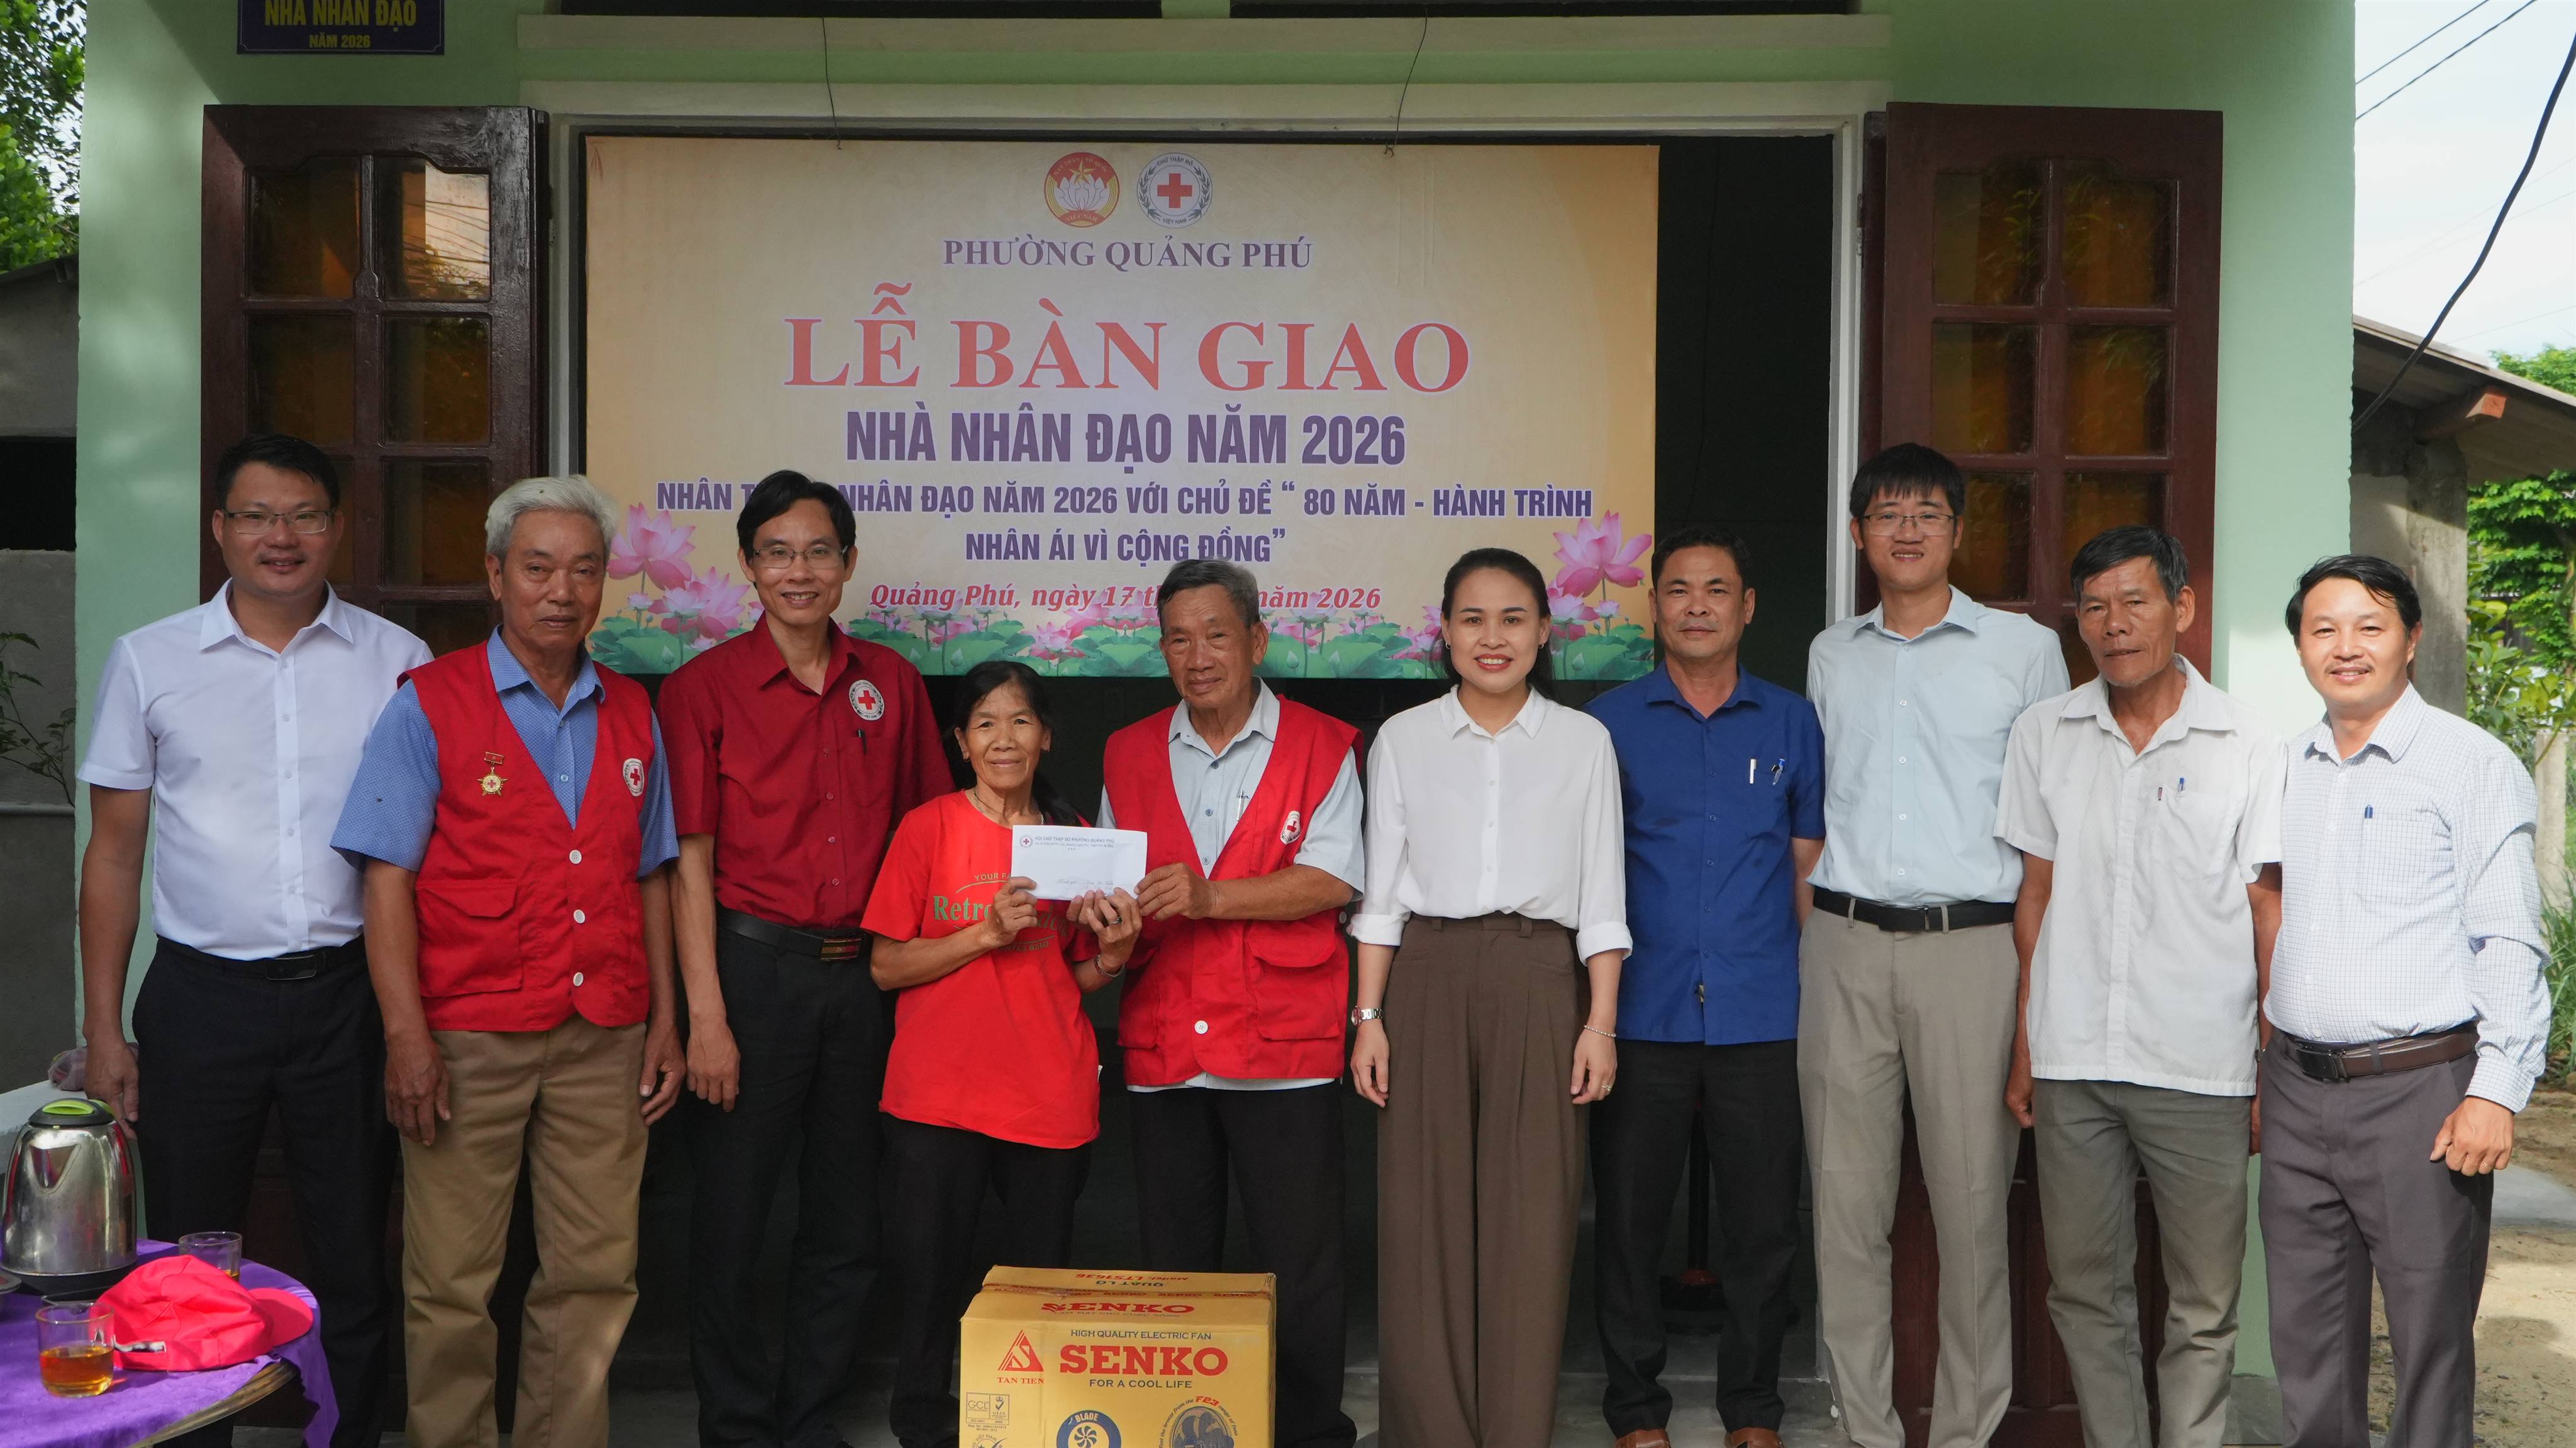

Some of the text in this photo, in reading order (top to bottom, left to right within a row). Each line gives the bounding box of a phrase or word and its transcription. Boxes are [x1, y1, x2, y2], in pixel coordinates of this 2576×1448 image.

[375, 0, 416, 32] ĐẠO
[309, 31, 370, 48] NĂM 2026
[943, 235, 1313, 271] PHƯỜNG QUẢNG PHÚ
[784, 282, 1470, 394] LỄ BÀN GIAO
[847, 401, 1406, 474] NHÀ NHÂN ĐẠO NĂM 2026
[657, 477, 731, 510] NHÂN
[838, 481, 912, 513] NHÂN
[921, 485, 974, 519] ĐẠO
[984, 481, 1044, 513] NĂM
[1053, 487, 1118, 514] 2026
[1126, 481, 1168, 515] VỚI
[1177, 480, 1230, 515] CHỦ
[1238, 479, 1272, 515] ĐỀ
[1304, 488, 1335, 516] 80
[1345, 482, 1406, 516] NĂM
[1433, 483, 1506, 518] HÀNH
[1514, 484, 1592, 518] TRÌNH
[966, 525, 1285, 567] NHÂN ÁI VÌ CỘNG ĐỒNG”
[870, 583, 957, 611] Quảng
[965, 584, 1021, 610] Phú,
[1031, 588, 1097, 612] ngày
[1101, 586, 1137, 608] 17
[1258, 585, 1309, 608] năm
[1320, 587, 1381, 609] 2026
[975, 872, 999, 881] YOUR
[1041, 1303, 1195, 1314] SENKO
[1070, 1330, 1096, 1338] HIGH
[1097, 1330, 1139, 1339] QUALITY
[1140, 1331, 1190, 1340] ELECTRIC
[1060, 1344, 1228, 1376] SENKO
[1128, 1380, 1163, 1388] COOL
[1074, 1412, 1099, 1422] BLADE
